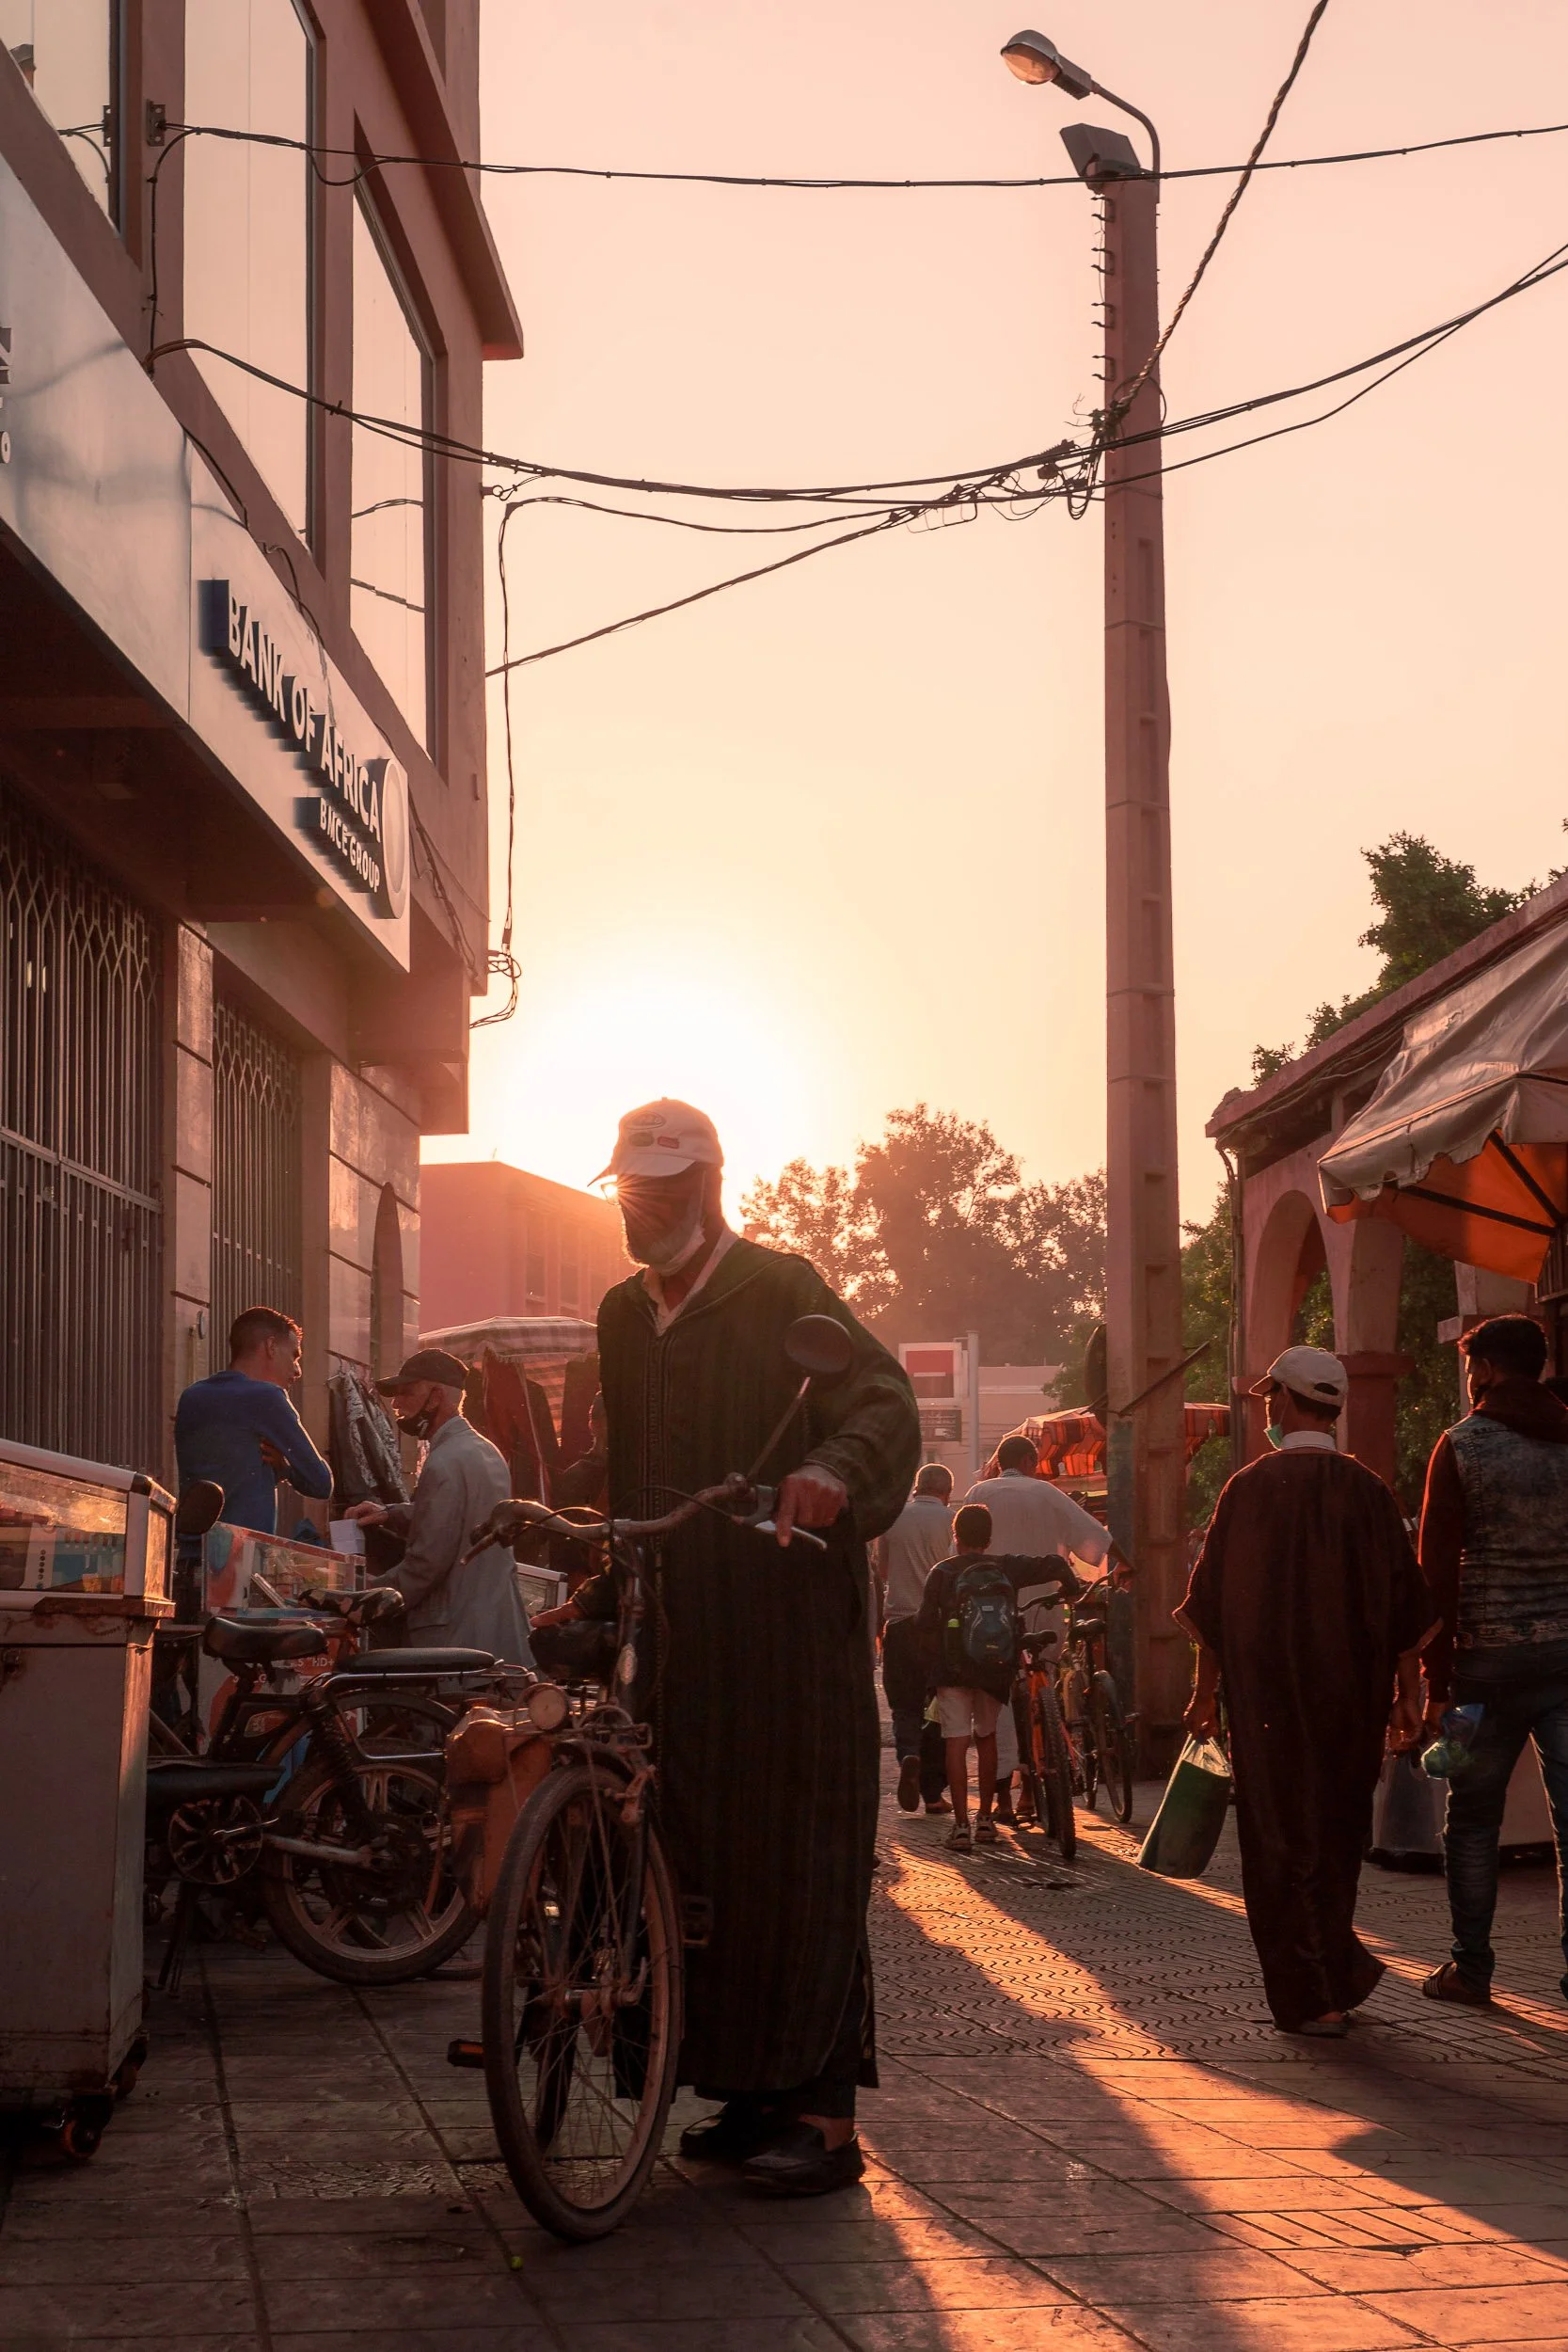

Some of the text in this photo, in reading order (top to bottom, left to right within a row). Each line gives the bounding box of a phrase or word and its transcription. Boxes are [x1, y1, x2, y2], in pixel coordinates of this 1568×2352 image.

[229, 581, 381, 843] BANK OF AFRICA
[320, 798, 381, 893] BMCE GROUP
